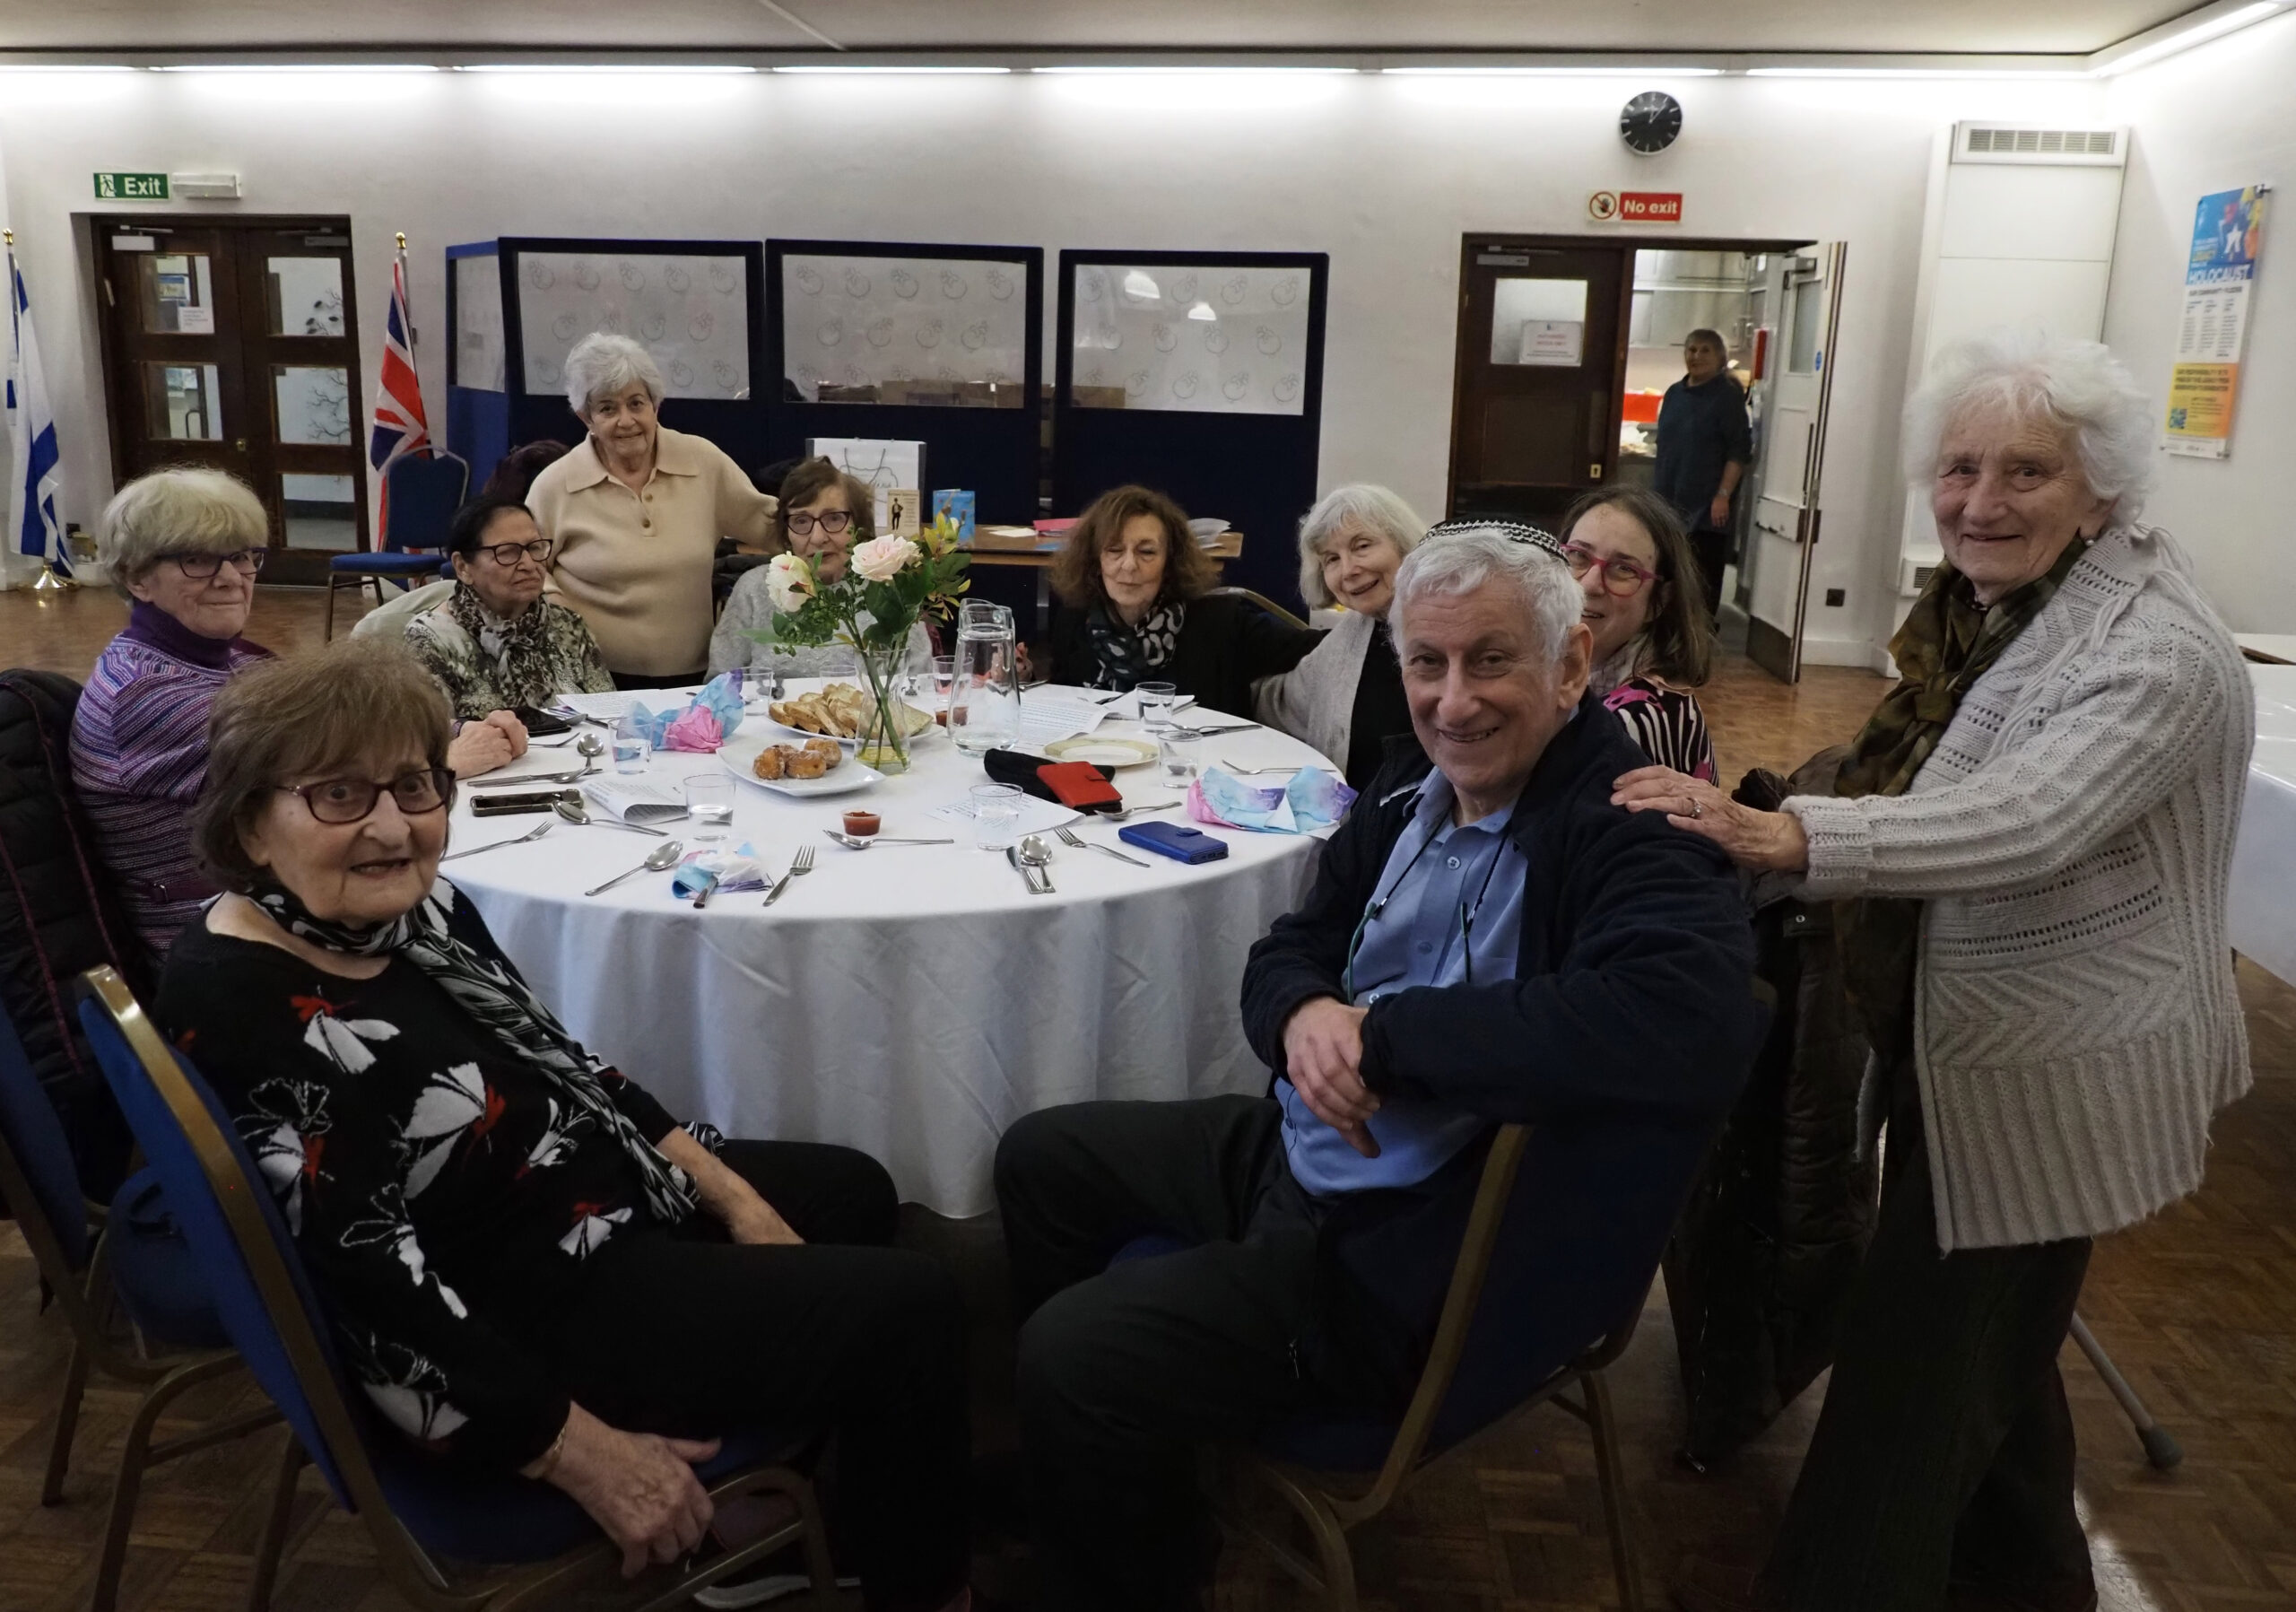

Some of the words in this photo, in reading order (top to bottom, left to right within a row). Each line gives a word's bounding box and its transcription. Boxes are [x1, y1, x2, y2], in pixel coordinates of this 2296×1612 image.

[124, 177, 161, 196] Exit
[1623, 200, 1645, 213] No
[1648, 201, 1678, 214] exit
[2188, 264, 2250, 284] HOLOCAUST
